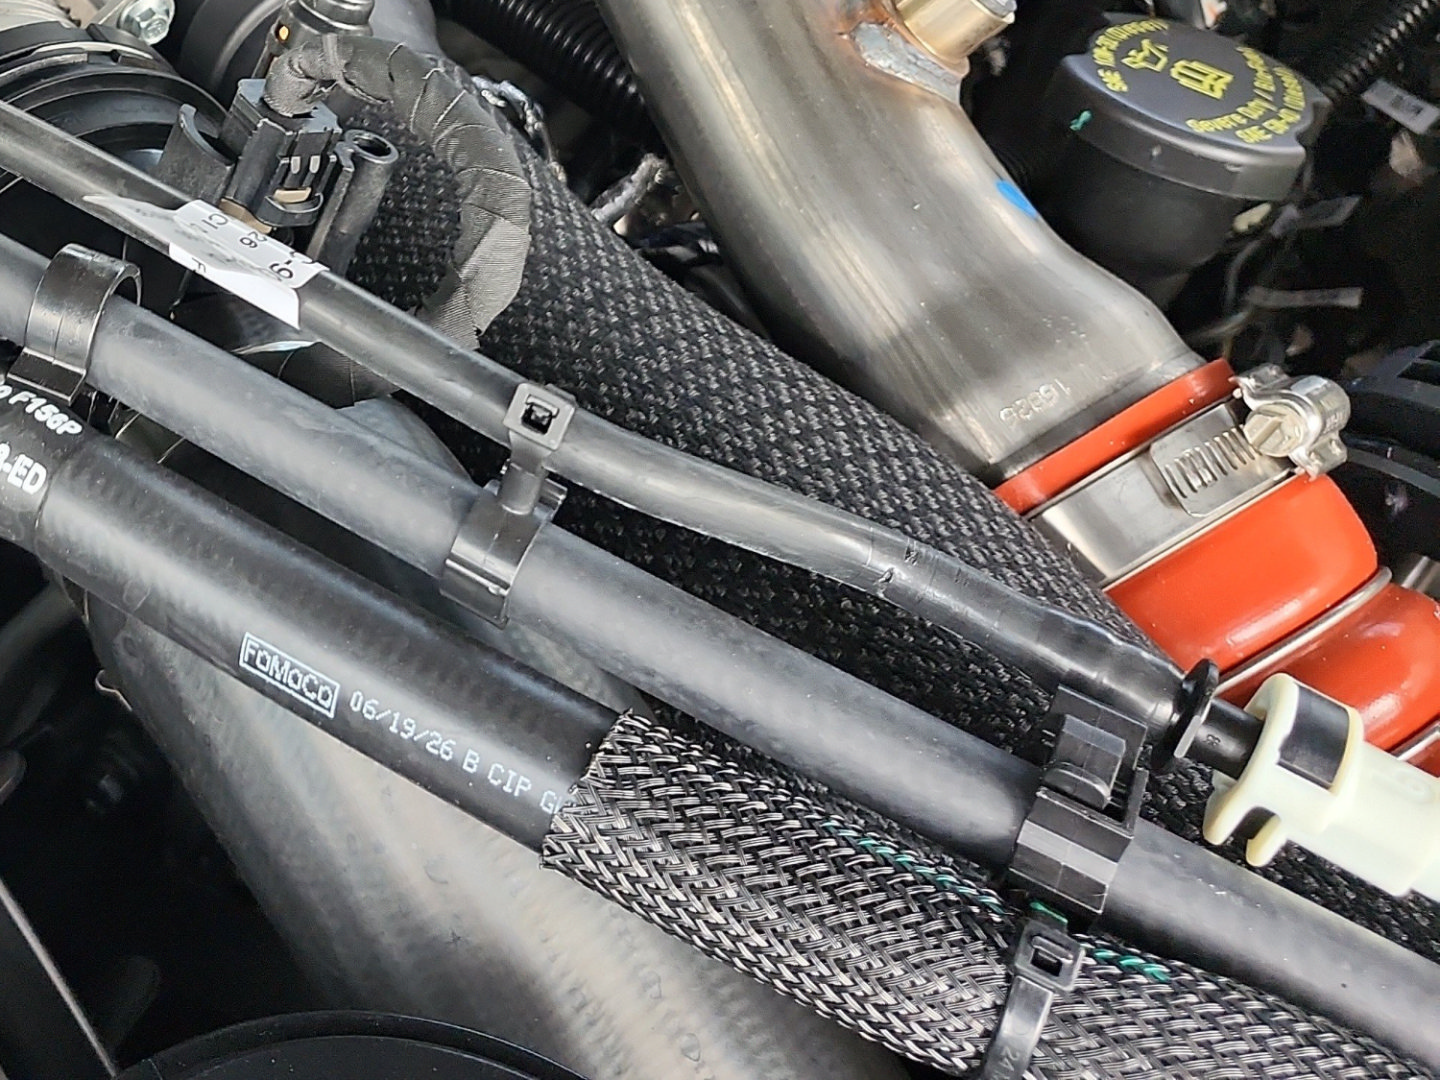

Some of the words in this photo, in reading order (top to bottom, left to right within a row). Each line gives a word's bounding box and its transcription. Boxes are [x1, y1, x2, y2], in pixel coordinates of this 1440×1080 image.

[8, 390, 83, 435] F156P
[243, 638, 335, 707] FoMoCo
[350, 691, 457, 761] 06/19/26
[462, 748, 480, 775] B
[487, 763, 531, 798] CIP
